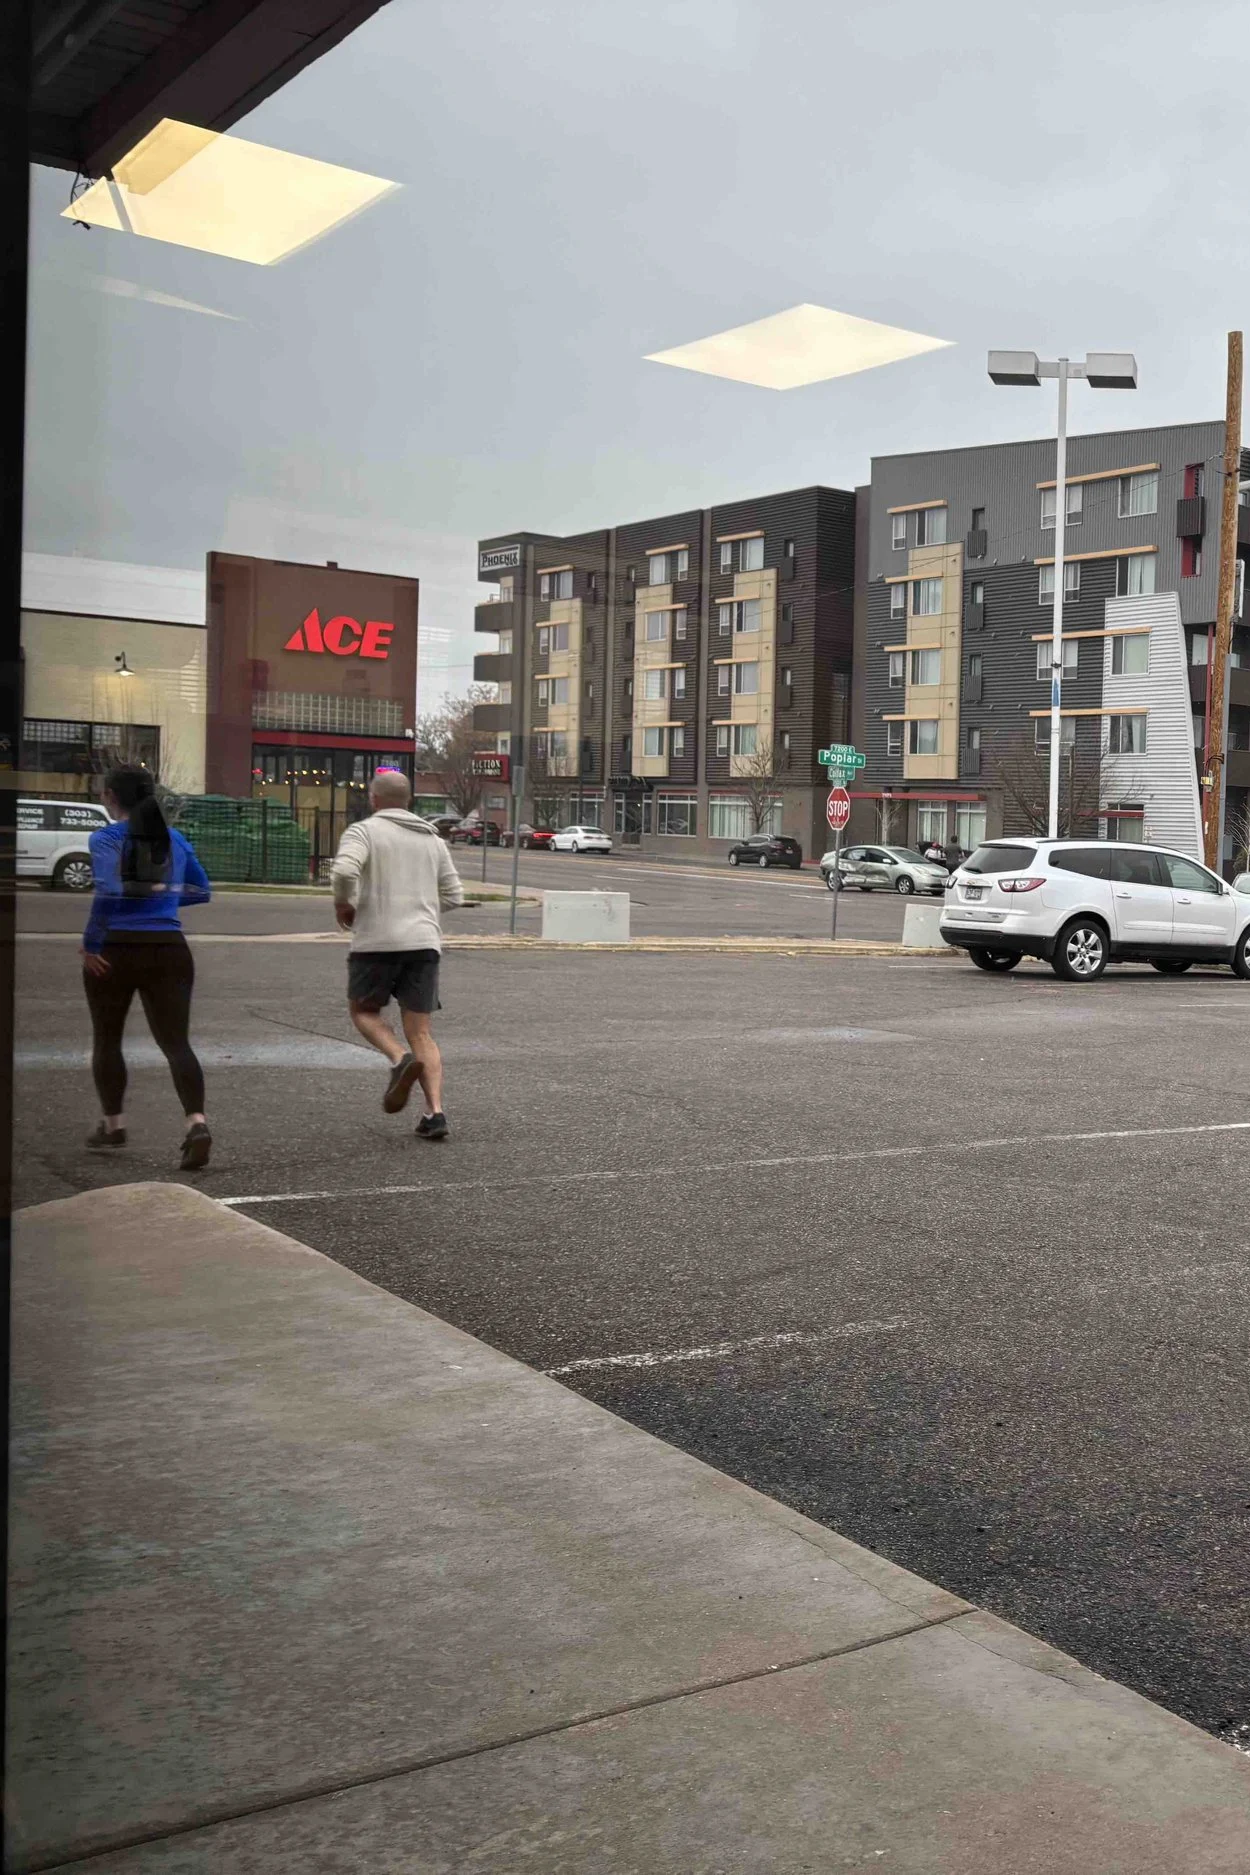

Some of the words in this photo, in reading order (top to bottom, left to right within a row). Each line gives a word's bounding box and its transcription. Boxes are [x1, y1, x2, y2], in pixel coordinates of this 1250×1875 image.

[482, 551, 517, 567] PHOENIX
[284, 607, 395, 659] ACE
[824, 750, 857, 765] Poplar
[829, 767, 846, 778] Colfax
[65, 809, 91, 818] (303)
[828, 800, 848, 817] STOP
